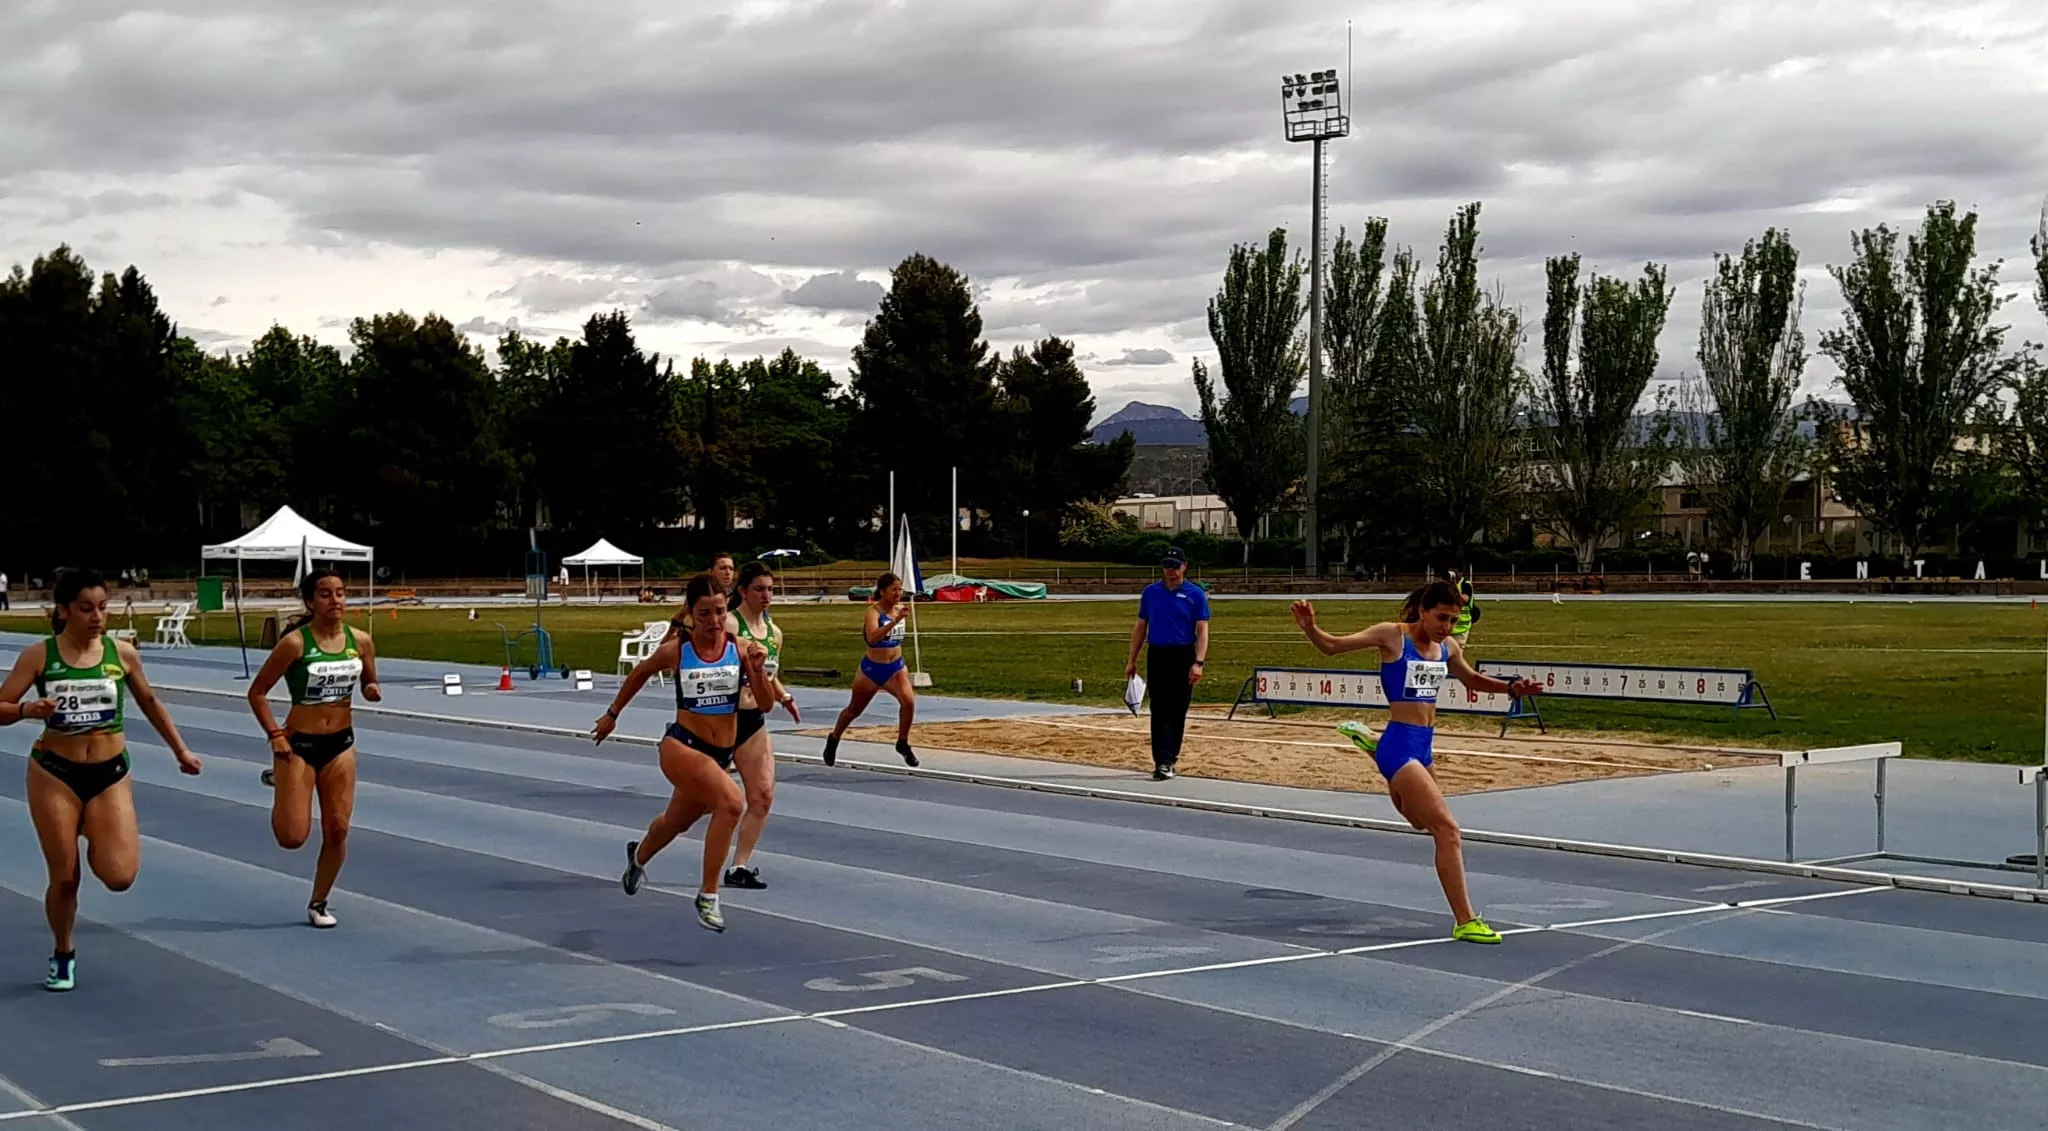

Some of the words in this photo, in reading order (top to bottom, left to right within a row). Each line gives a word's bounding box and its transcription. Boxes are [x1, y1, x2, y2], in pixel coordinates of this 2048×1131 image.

[317, 674, 335, 687] 28
[1413, 673, 1427, 686] 16
[1546, 672, 1555, 687] 6
[1619, 675, 1628, 690] 7
[1696, 678, 1705, 694] 8
[696, 682, 706, 695] 5
[1257, 677, 1268, 693] 13
[1319, 679, 1332, 695] 14
[1466, 688, 1478, 703] 16
[56, 695, 79, 711] 28
